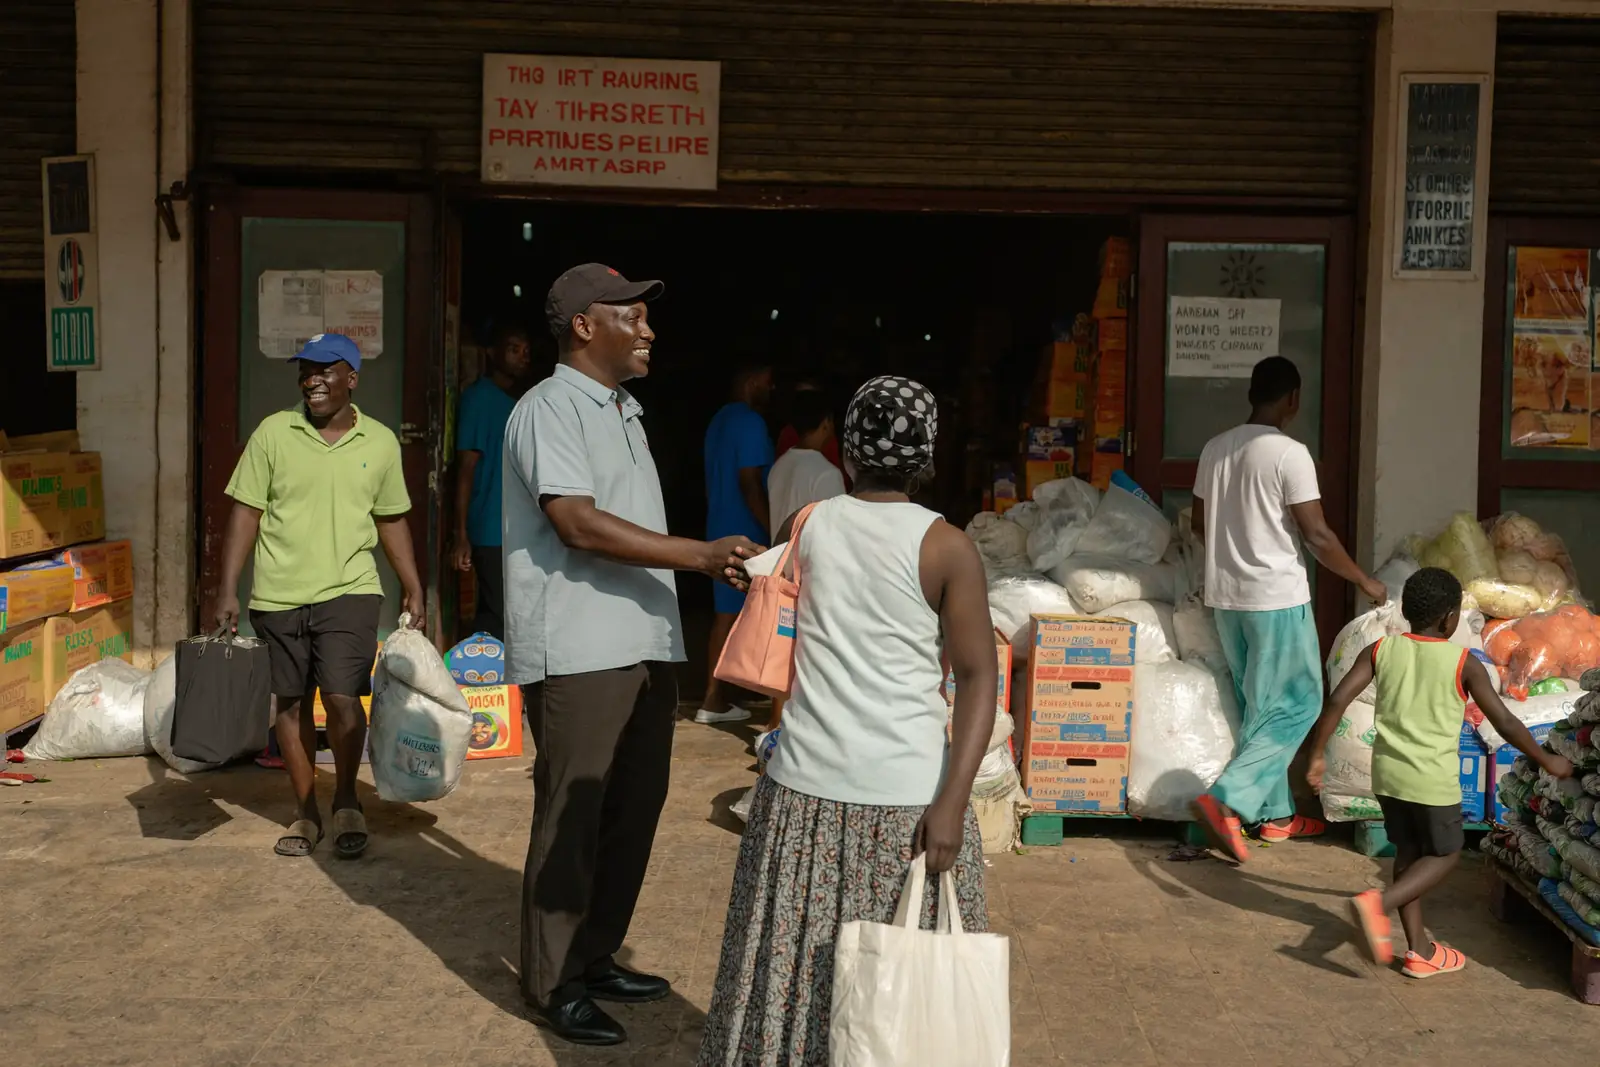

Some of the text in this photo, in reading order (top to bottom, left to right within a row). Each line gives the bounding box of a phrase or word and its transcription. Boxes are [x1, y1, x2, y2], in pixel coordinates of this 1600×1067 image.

[558, 68, 594, 87] IRT
[602, 70, 698, 92] RAURING
[495, 97, 539, 121] TAY
